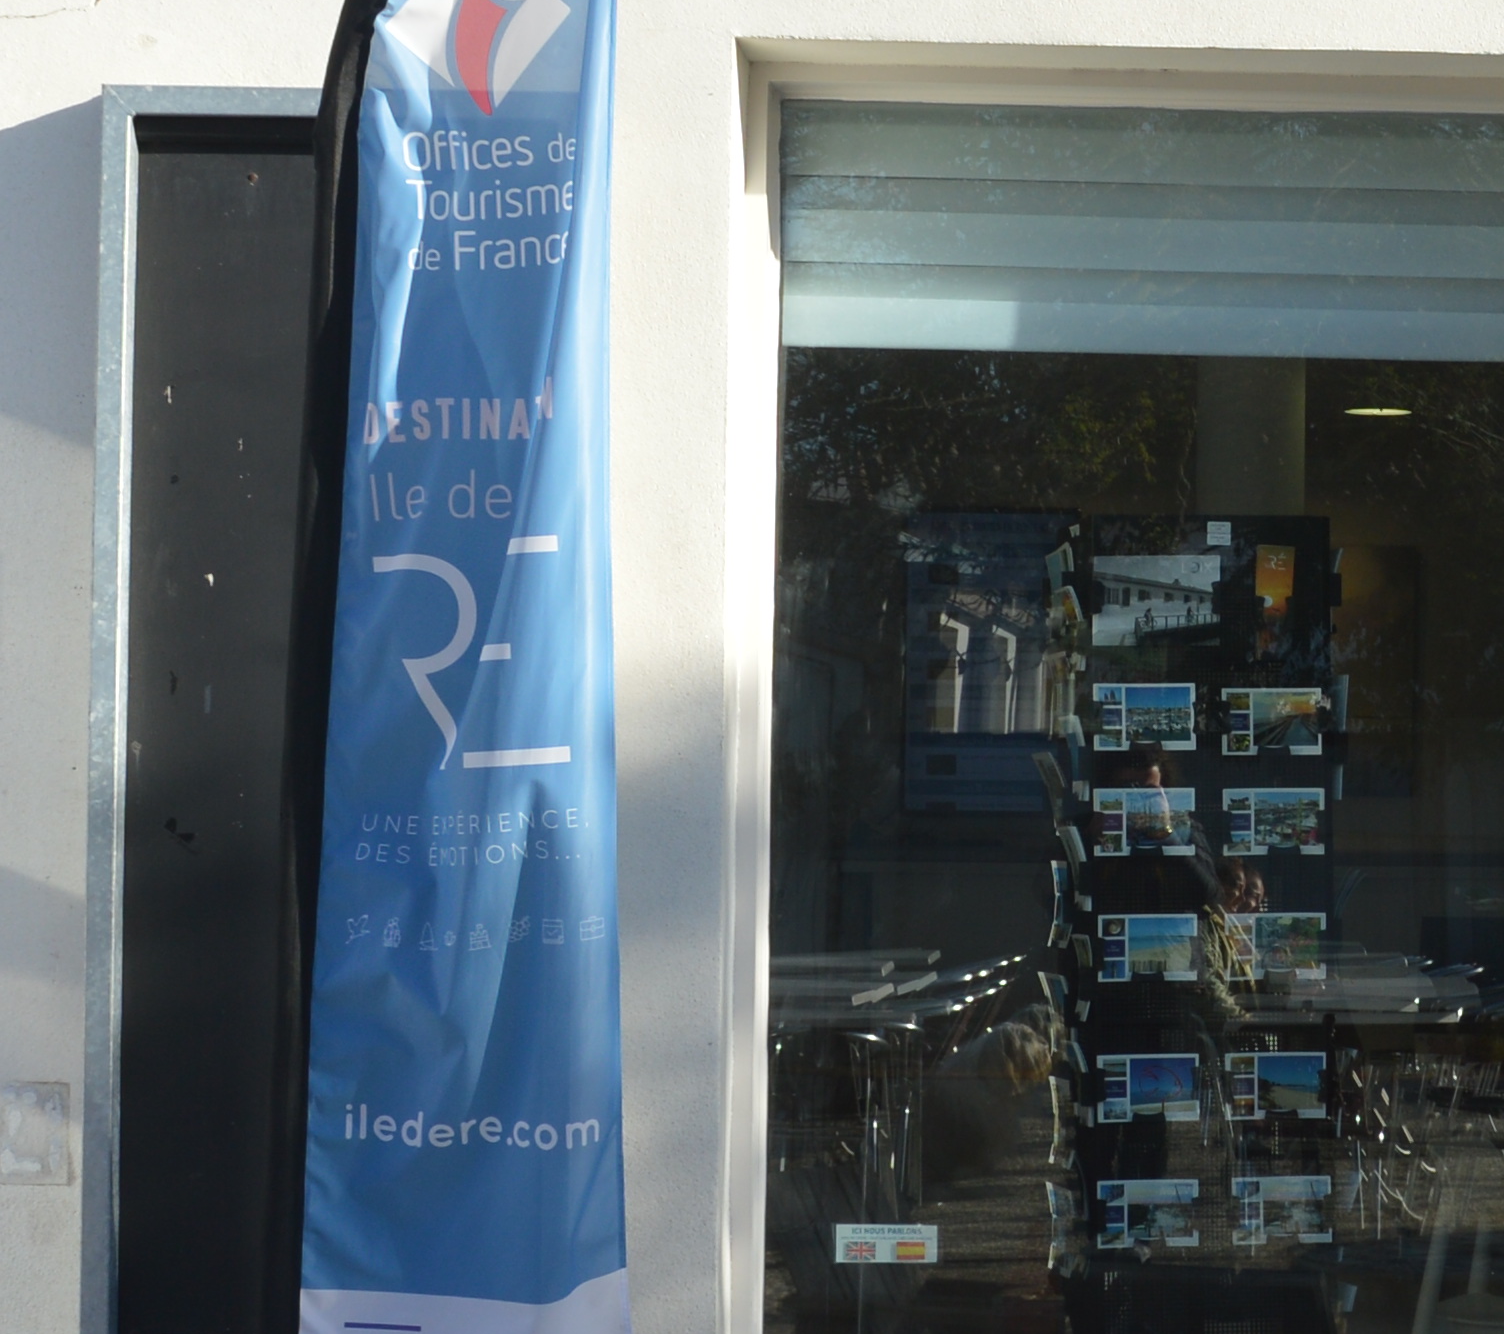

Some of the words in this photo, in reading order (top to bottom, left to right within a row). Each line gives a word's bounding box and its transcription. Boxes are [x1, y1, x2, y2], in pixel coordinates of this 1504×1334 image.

[402, 130, 534, 171] Offices
[405, 179, 573, 221] Tourisme
[407, 241, 441, 270] de
[448, 468, 512, 519] de
[361, 814, 420, 835] UNE
[355, 843, 411, 864] DES
[344, 1103, 601, 1152] iledere.com
[851, 1227, 862, 1235] ICI
[864, 1227, 885, 1235] NOUS
[887, 1227, 922, 1235] PARLONS
